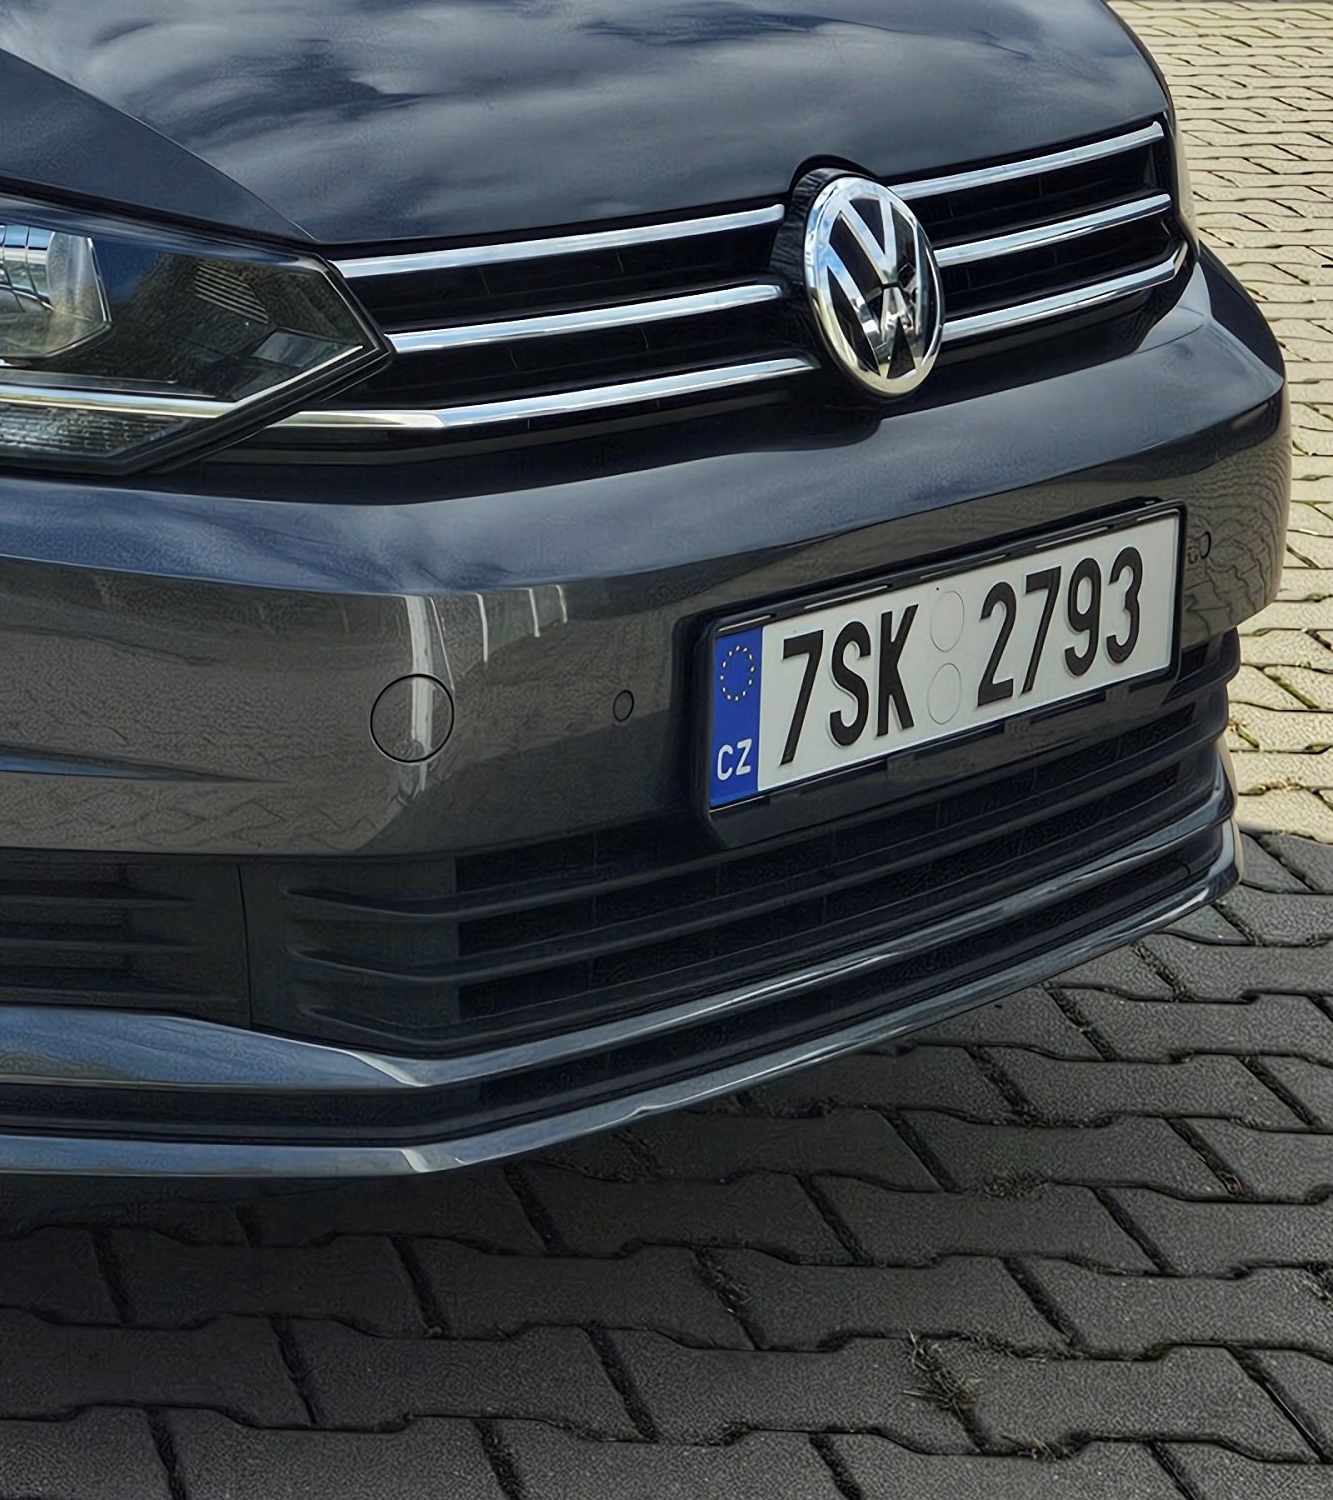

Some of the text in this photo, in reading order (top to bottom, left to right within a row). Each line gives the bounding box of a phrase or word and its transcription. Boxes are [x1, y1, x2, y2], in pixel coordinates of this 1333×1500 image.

[778, 546, 1144, 767] 7SK 2793
[716, 739, 752, 781] CZ
